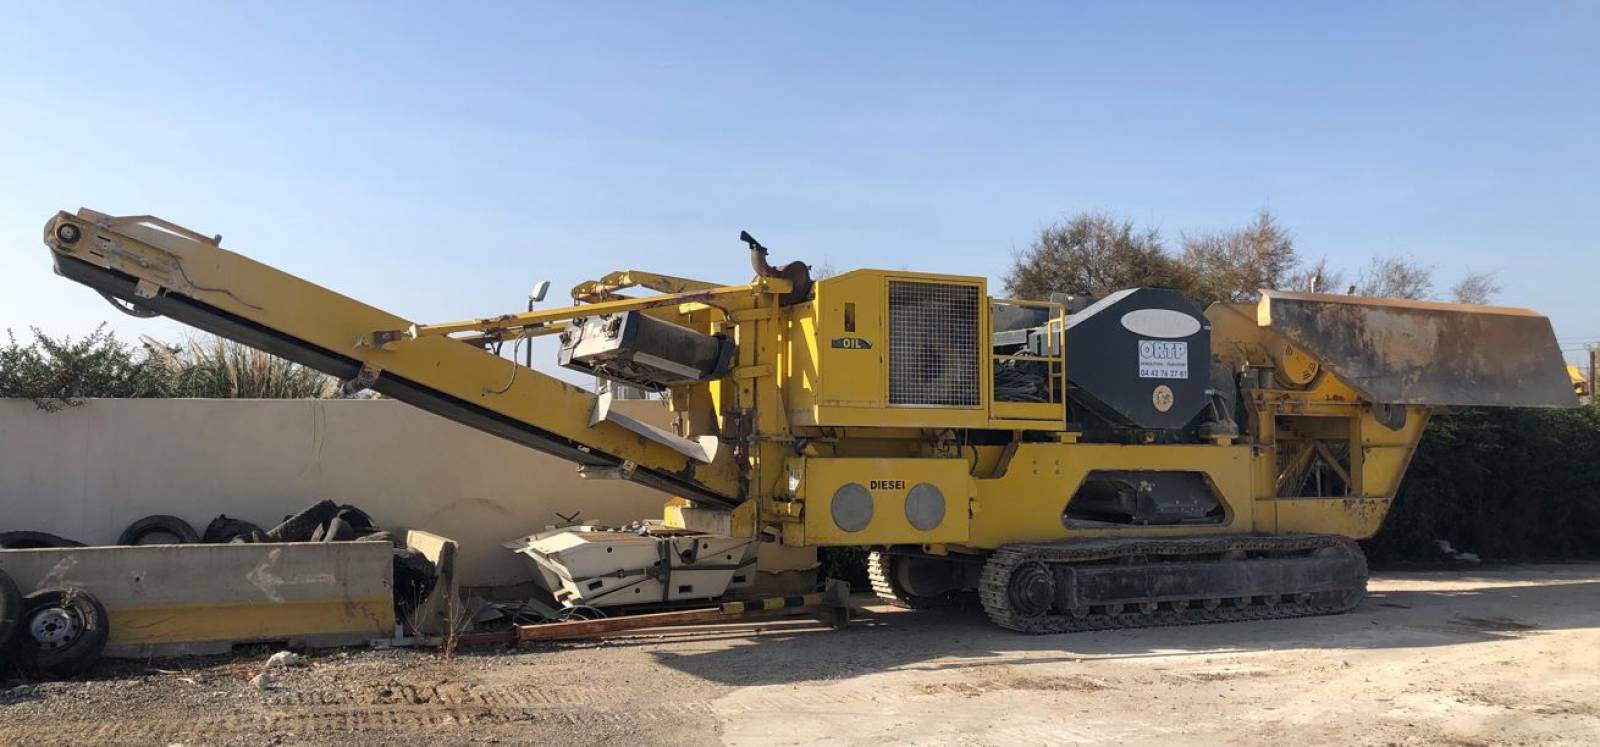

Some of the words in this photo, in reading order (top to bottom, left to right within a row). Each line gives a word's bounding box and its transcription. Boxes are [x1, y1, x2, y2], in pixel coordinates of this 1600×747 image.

[843, 338, 862, 349] OIL
[1140, 341, 1187, 360] ORTP
[1140, 369, 1149, 377] 04
[1151, 369, 1159, 377] 42
